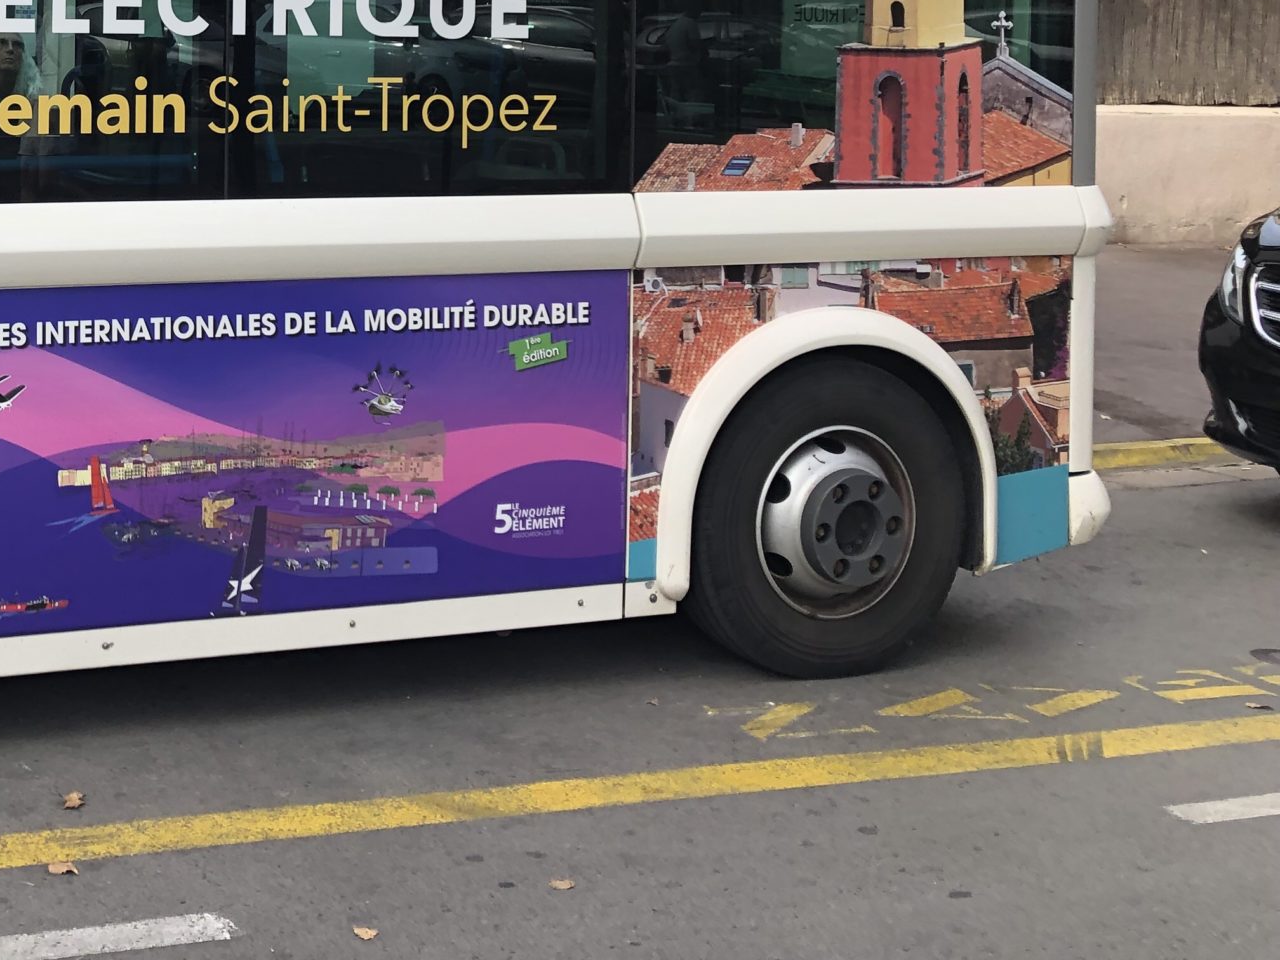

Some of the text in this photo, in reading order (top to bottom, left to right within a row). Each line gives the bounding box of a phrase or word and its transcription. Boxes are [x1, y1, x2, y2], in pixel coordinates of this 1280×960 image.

[207, 74, 558, 149] Saint-Tropez
[35, 312, 277, 346] INTERNATIONALES
[283, 311, 317, 336] DE
[324, 309, 357, 334] LA
[363, 299, 476, 333] MOBILITÉ
[482, 301, 590, 328] DURABLE
[522, 347, 560, 364] édition
[493, 502, 513, 535] 5
[511, 504, 566, 520] CINQUIÈME
